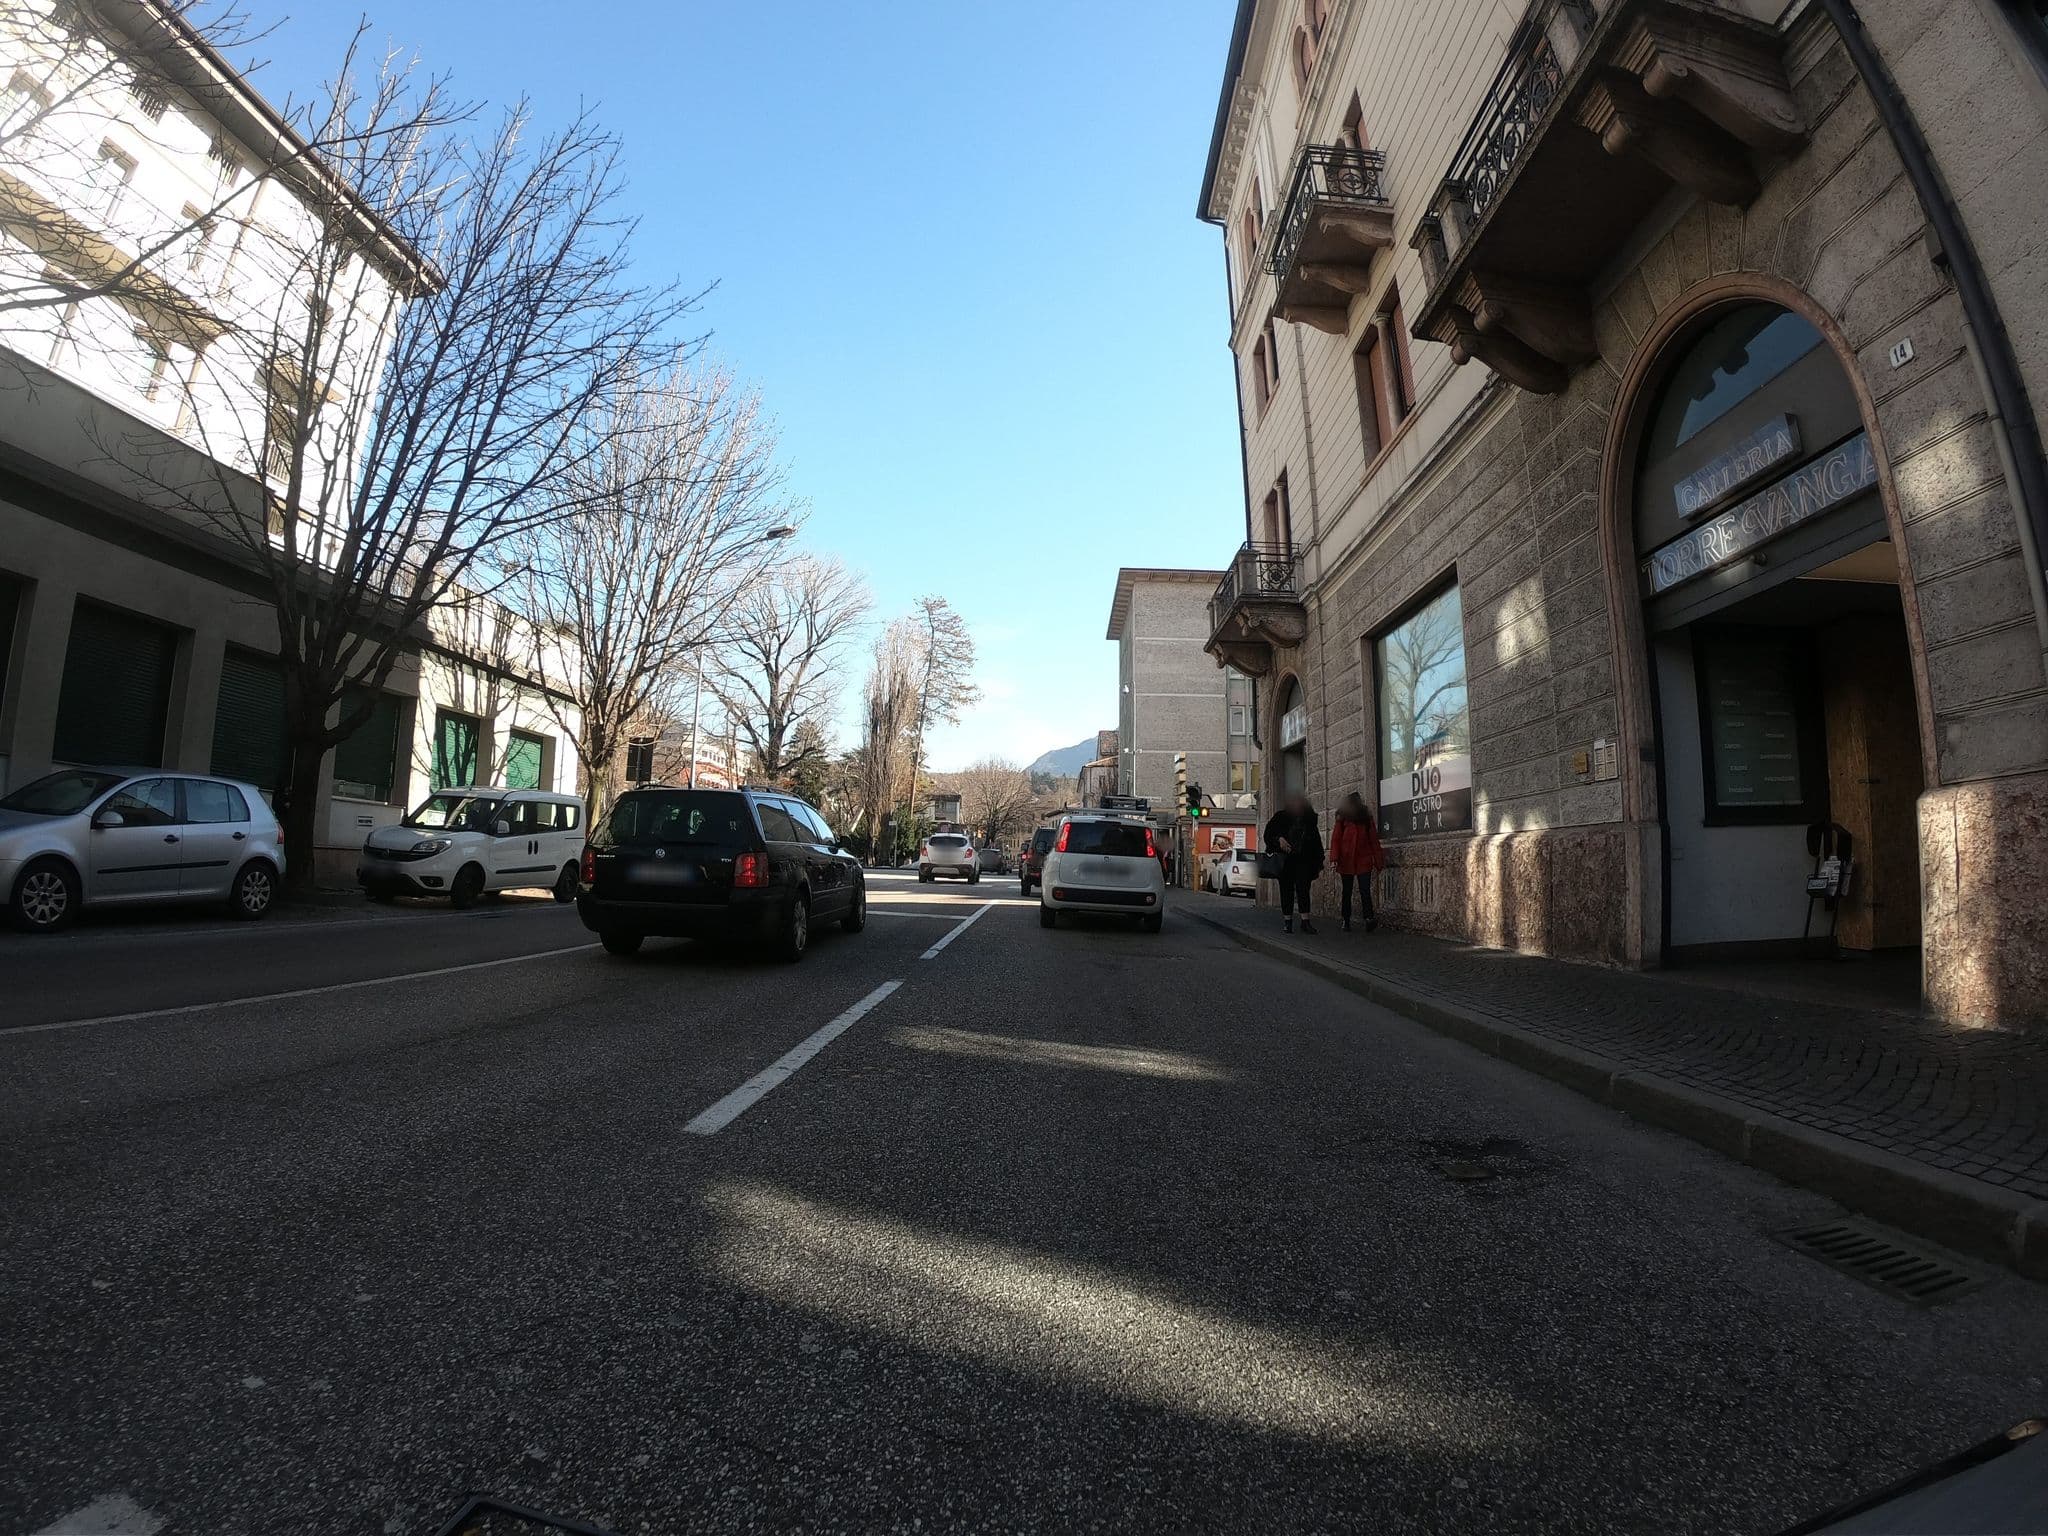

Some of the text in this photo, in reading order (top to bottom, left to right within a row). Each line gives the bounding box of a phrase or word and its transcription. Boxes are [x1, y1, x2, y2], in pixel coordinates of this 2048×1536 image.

[1894, 344, 1907, 363] 14
[1681, 431, 1792, 512] GALLERIA
[1411, 767, 1441, 797] DUO
[1412, 795, 1442, 814] GASTRO
[1412, 813, 1442, 831] BAR
